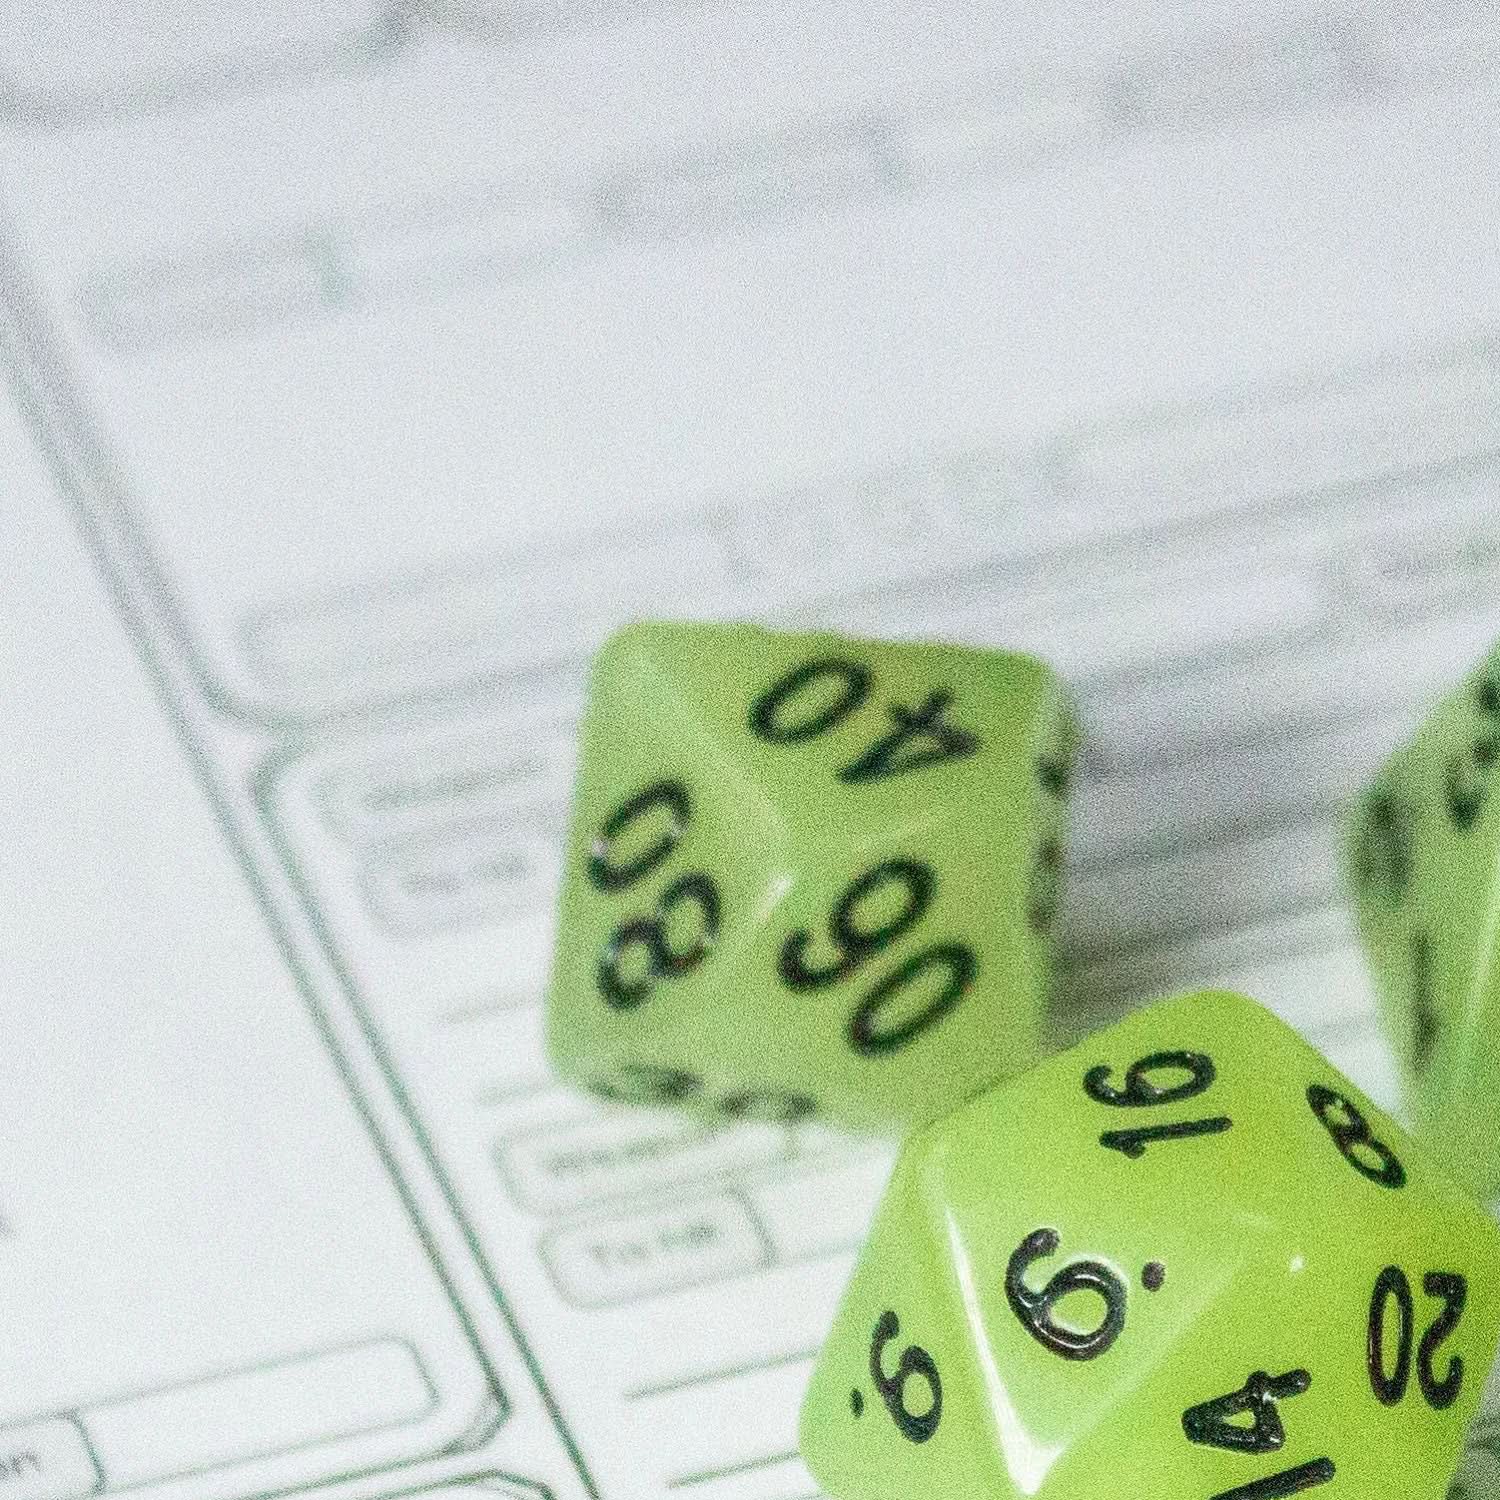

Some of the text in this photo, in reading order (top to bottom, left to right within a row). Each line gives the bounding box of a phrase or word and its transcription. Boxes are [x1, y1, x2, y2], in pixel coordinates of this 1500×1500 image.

[747, 653, 983, 787] 40
[585, 777, 724, 1013] 80
[774, 854, 981, 1060] 90
[1304, 1082, 1409, 1191] 8
[1364, 1263, 1471, 1413] 20
